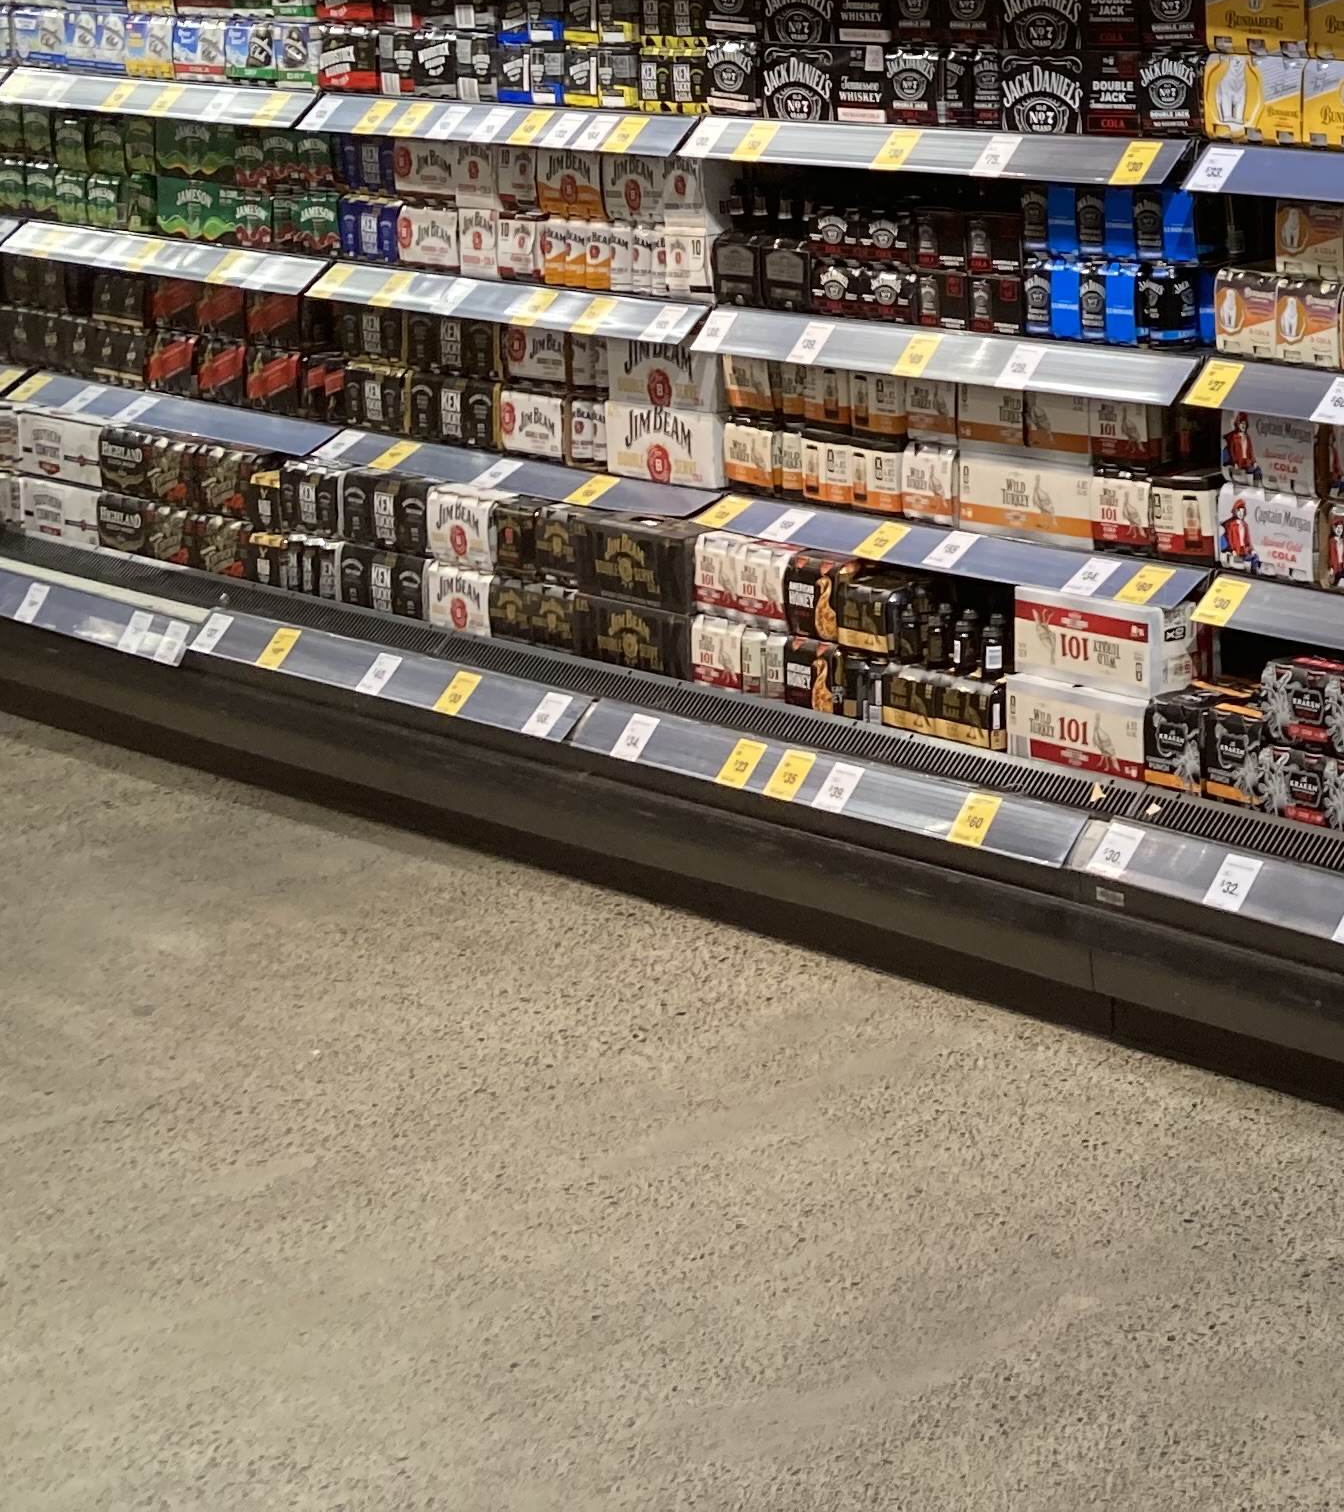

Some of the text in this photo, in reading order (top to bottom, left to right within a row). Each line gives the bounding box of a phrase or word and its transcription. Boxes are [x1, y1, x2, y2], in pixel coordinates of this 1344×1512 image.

[1002, 65, 1083, 112] JACK DANIEL'S
[1092, 81, 1133, 91] DOUBLE
[1100, 92, 1126, 102] JACK
[625, 405, 692, 458] JIM BEAM
[1058, 718, 1088, 743] 101
